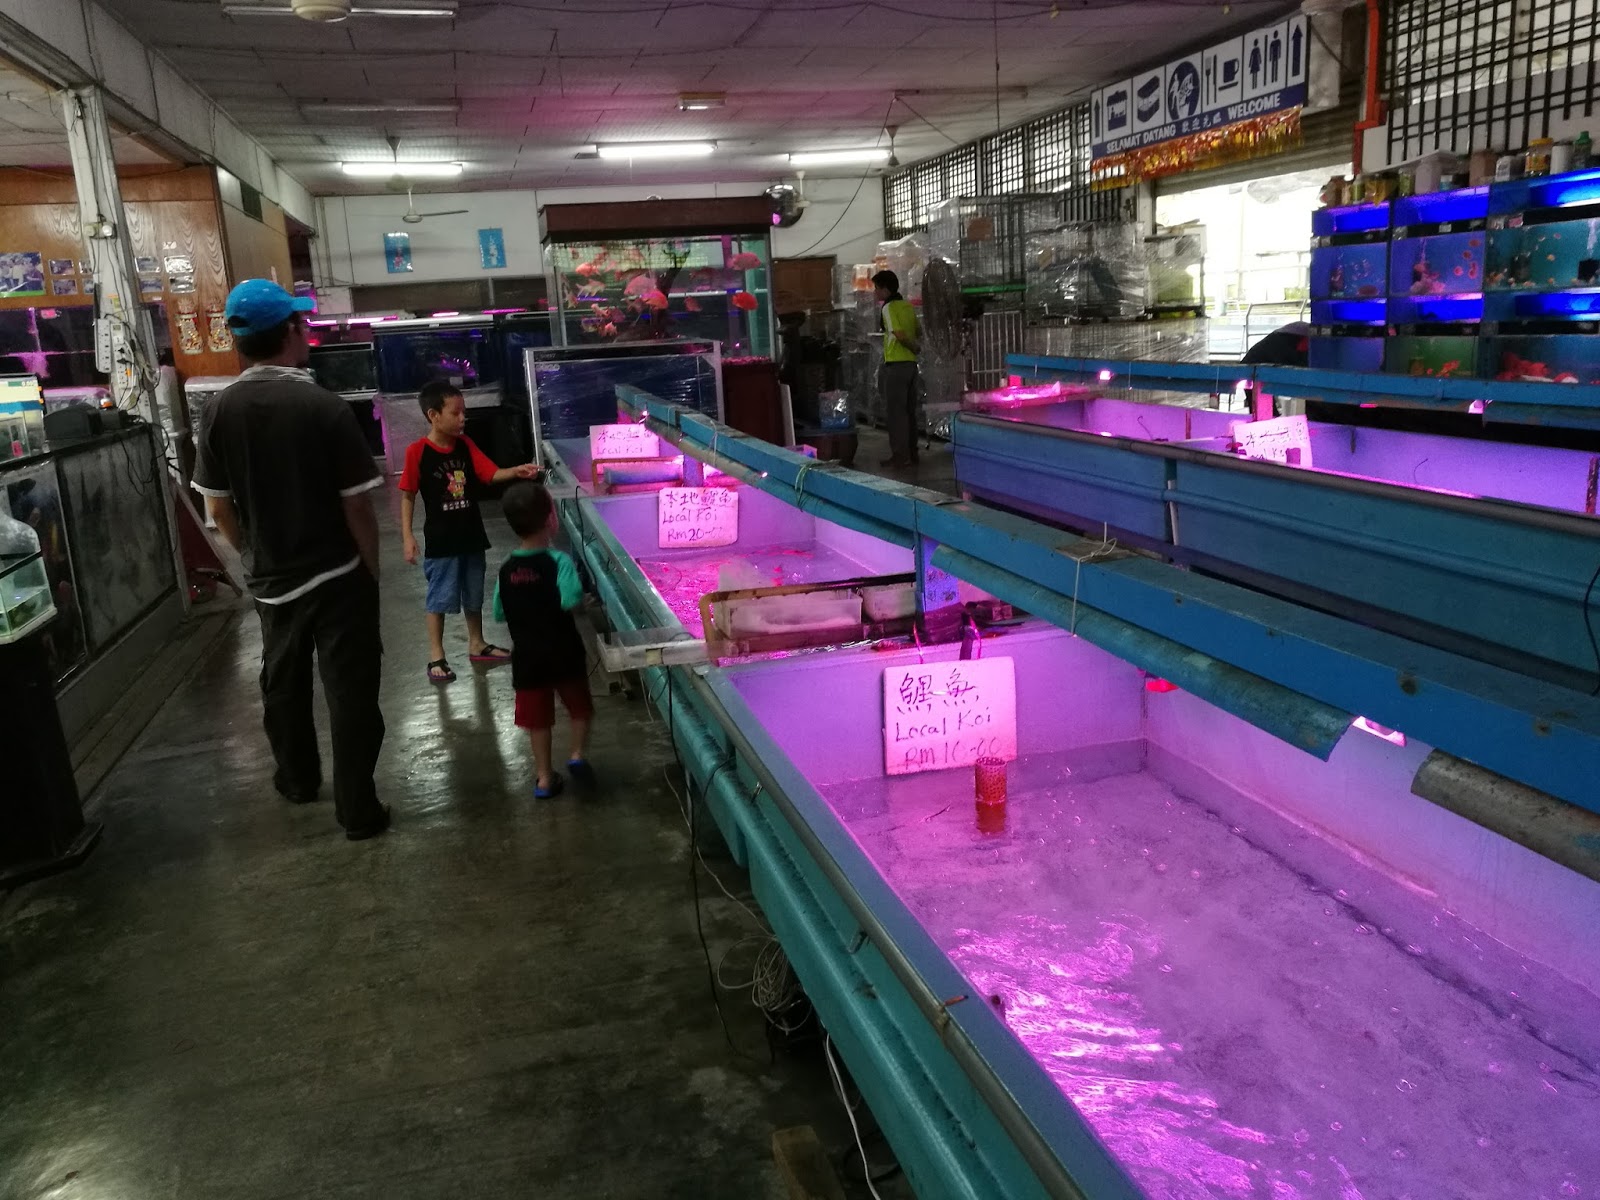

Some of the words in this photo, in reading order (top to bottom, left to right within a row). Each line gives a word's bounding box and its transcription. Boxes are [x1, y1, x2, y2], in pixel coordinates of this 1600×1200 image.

[1227, 92, 1281, 120] WELCOME
[1106, 133, 1141, 154] SELAMAT
[1143, 124, 1177, 144] DATANG
[663, 510, 691, 525] Local
[896, 717, 946, 742] Local
[958, 706, 992, 731] Koi
